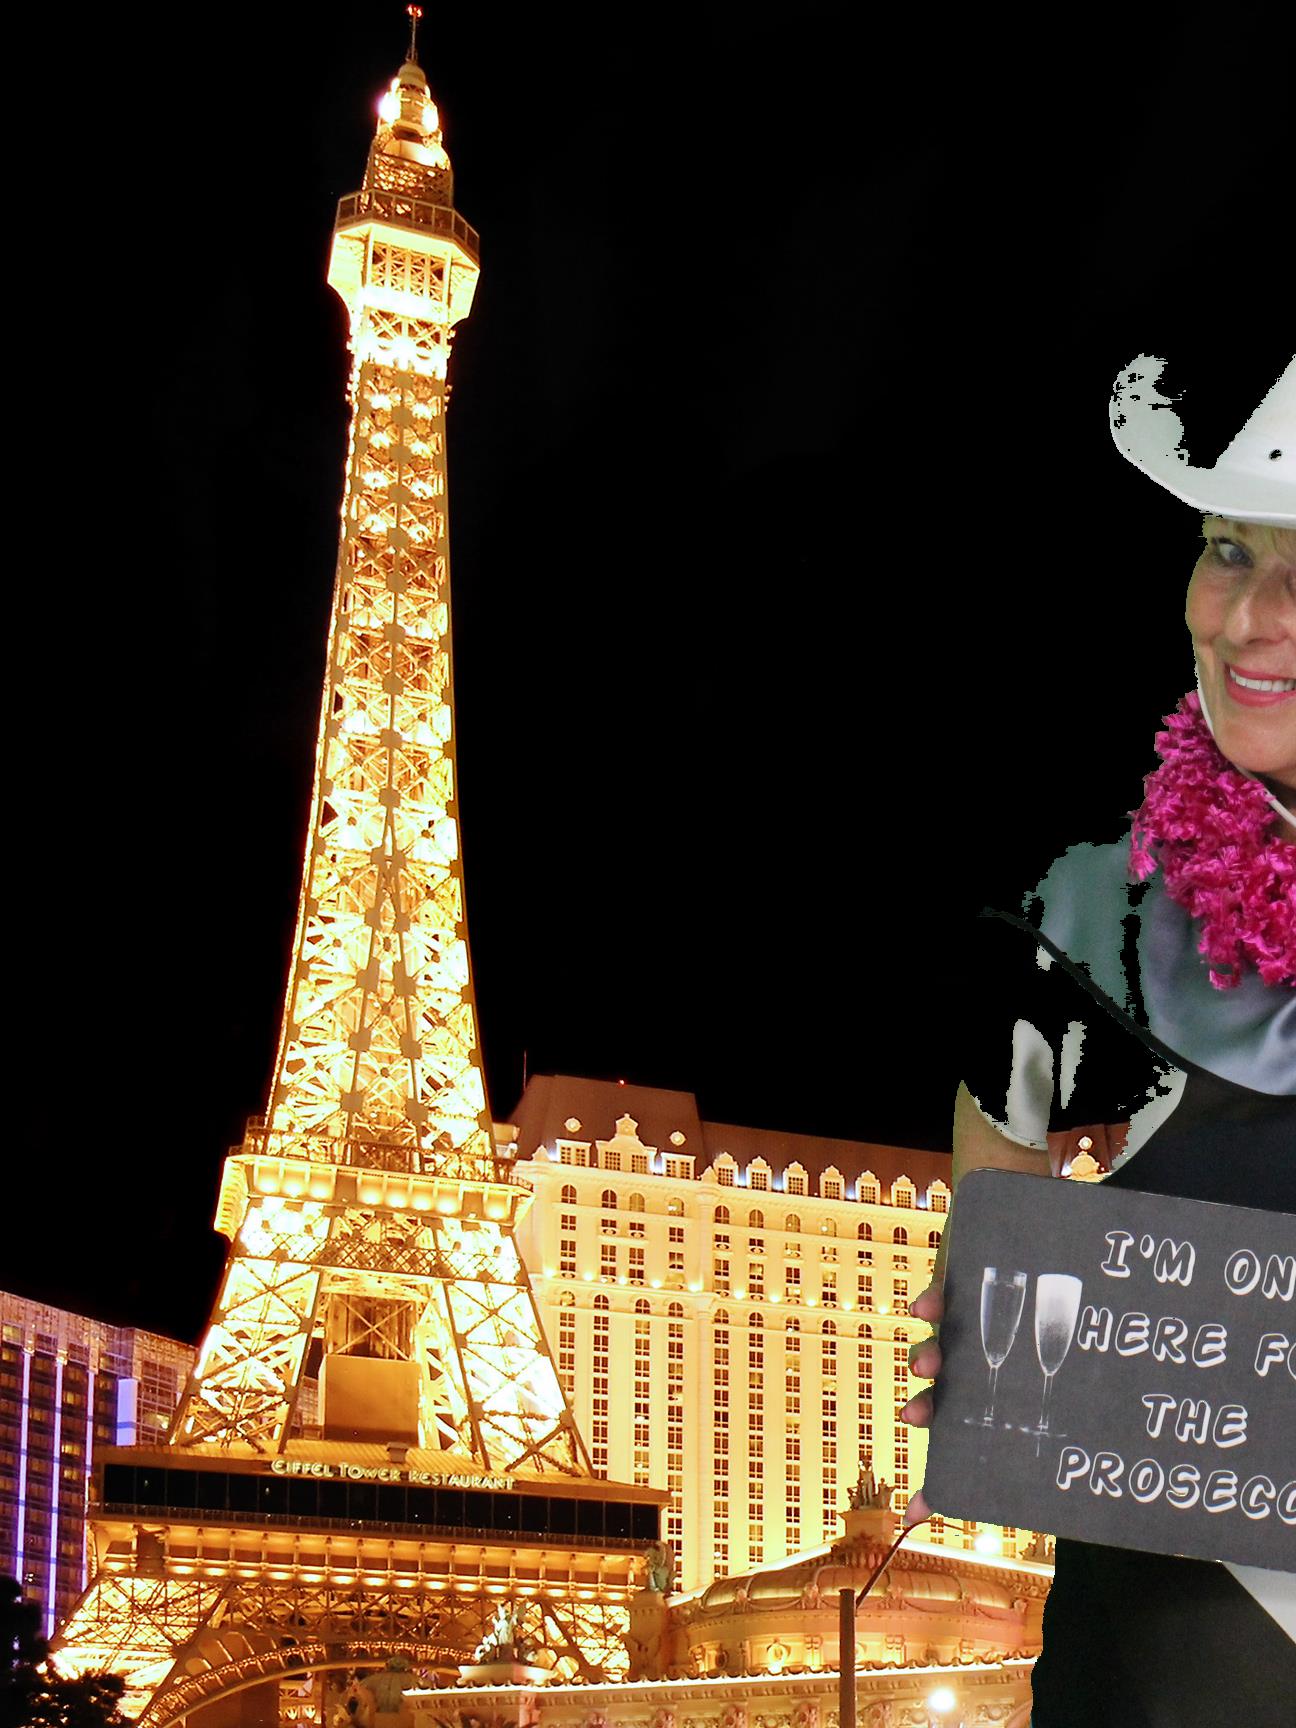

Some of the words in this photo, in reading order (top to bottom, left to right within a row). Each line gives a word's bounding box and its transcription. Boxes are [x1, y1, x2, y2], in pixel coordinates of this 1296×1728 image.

[1101, 1231, 1195, 1287] I'M
[1077, 1305, 1227, 1367] HERE
[1142, 1394, 1248, 1448] THE
[271, 1459, 334, 1478] EIFFEL
[339, 1462, 400, 1481] TOWER
[408, 1470, 514, 1490] RESTAURANT
